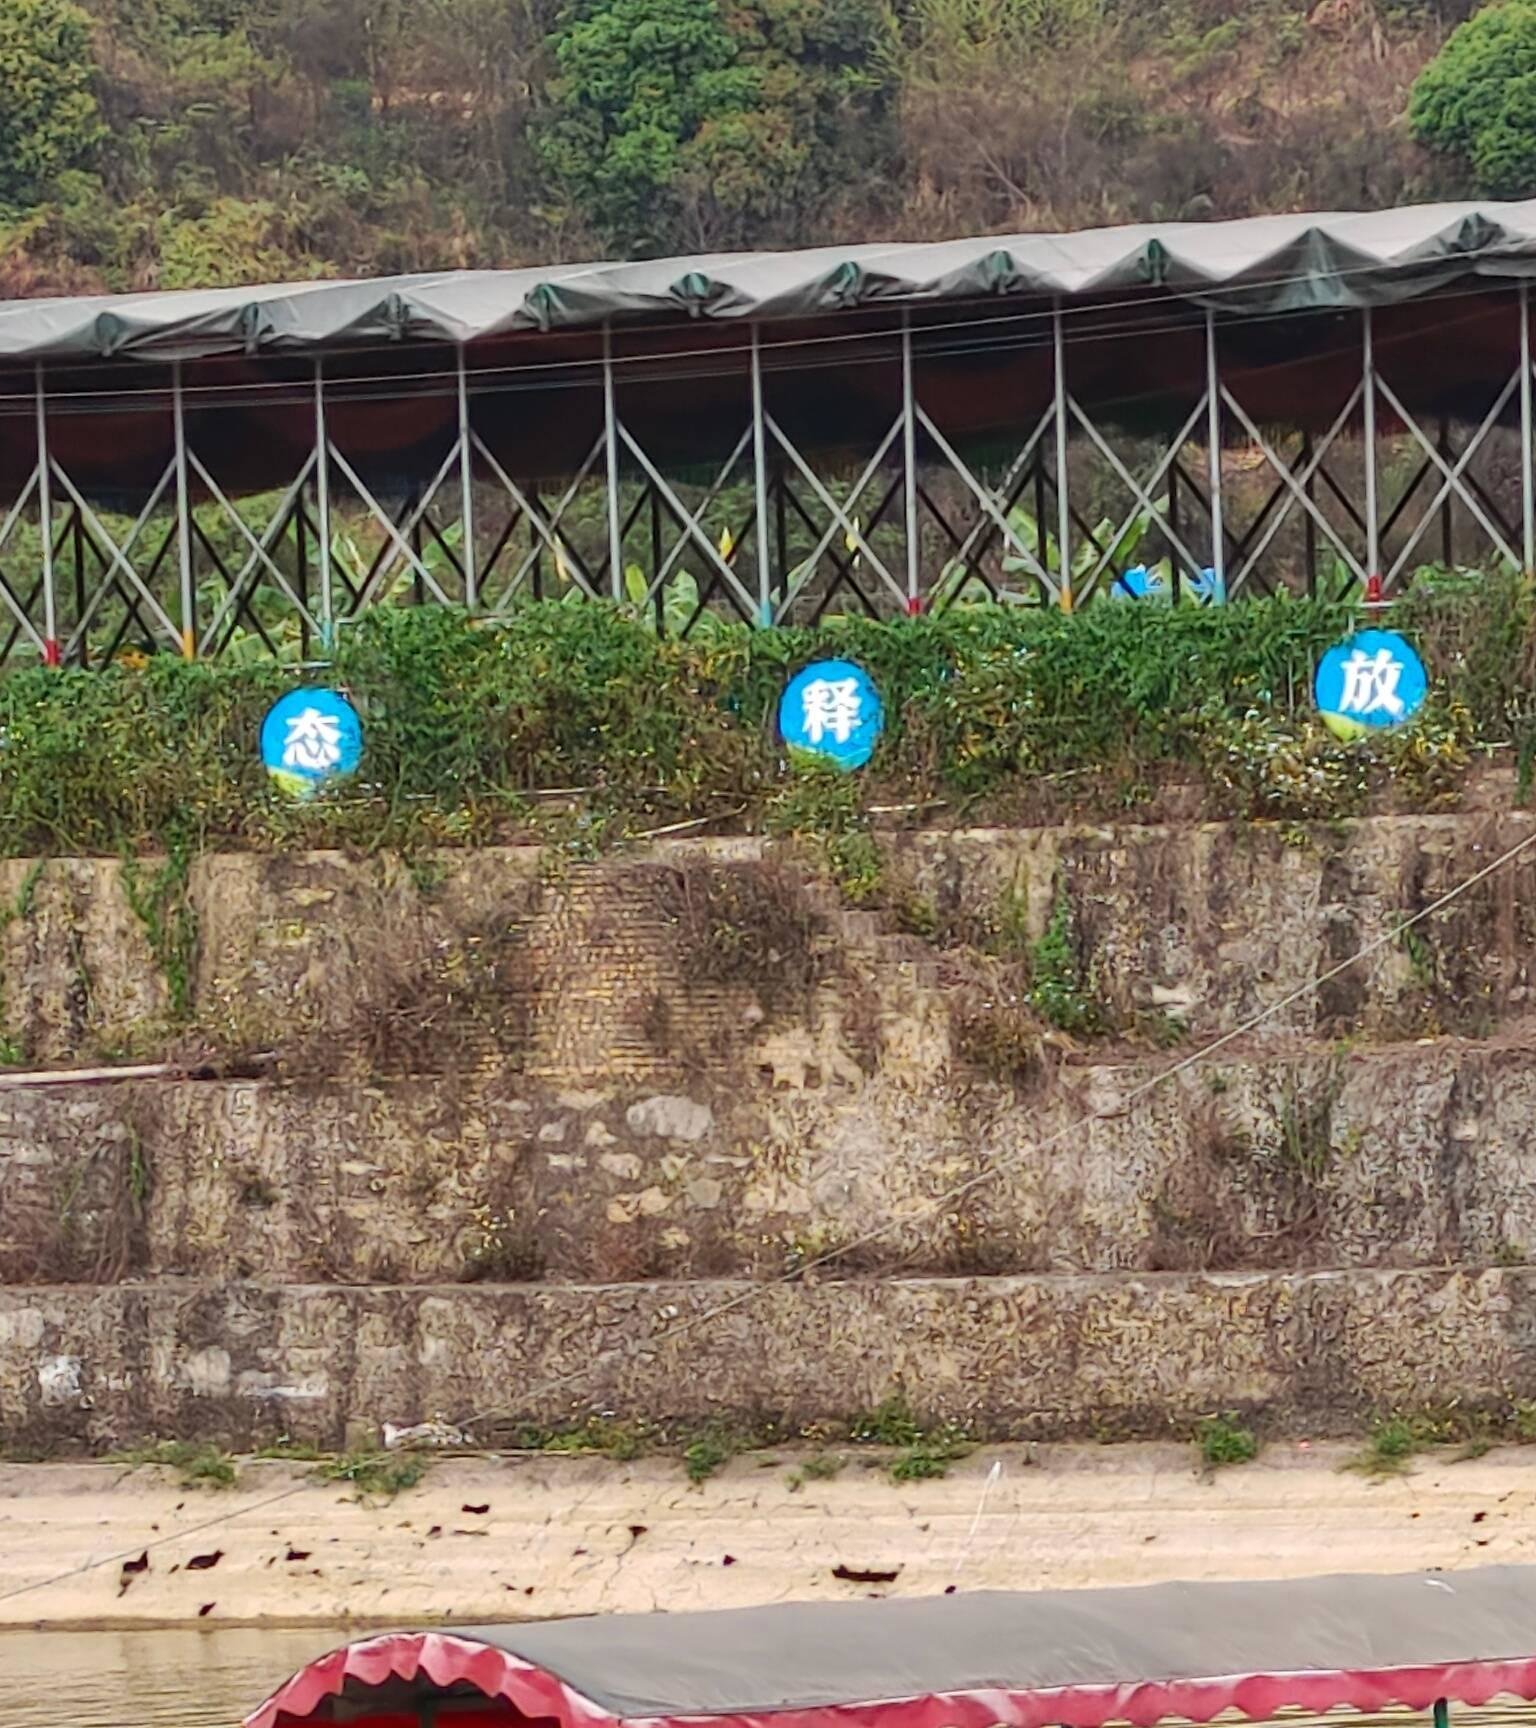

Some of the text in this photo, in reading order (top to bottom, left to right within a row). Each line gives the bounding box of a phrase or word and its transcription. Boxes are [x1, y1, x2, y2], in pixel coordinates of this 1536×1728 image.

[803, 679, 861, 742] 释
[1340, 650, 1403, 715] 放
[283, 709, 340, 771] 态
